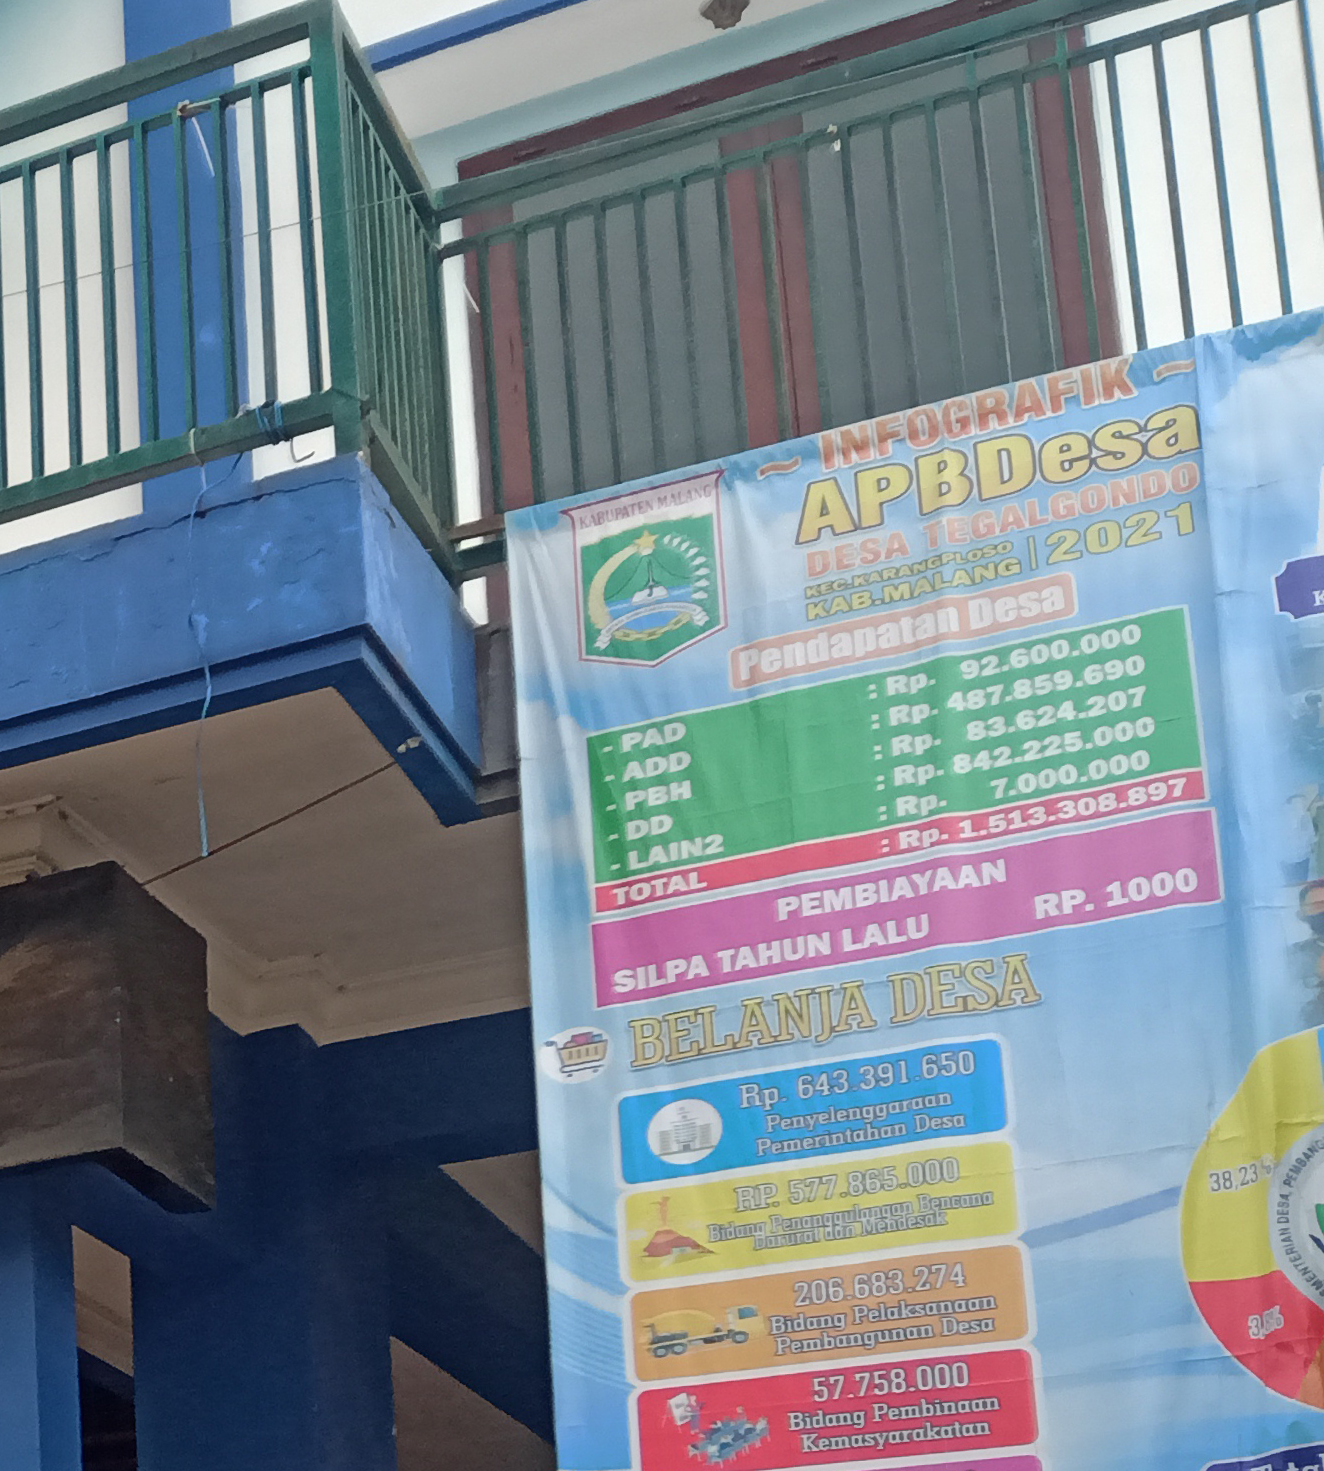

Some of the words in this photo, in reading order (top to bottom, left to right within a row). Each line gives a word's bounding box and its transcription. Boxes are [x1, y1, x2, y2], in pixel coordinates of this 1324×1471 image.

[822, 357, 1138, 471] INFOGRAFIK
[579, 501, 654, 530] KABUPATEN
[656, 484, 713, 510] MALANG
[795, 404, 1200, 545] APBDesa
[806, 530, 910, 579] DESA
[923, 461, 1200, 550] TEGALGONDO
[806, 557, 1021, 622] KAB.MALANG
[1045, 502, 1194, 565] 2021
[806, 541, 1013, 598] KEC.KARANGPLOSO
[738, 602, 960, 684] Pendapatan
[968, 584, 1065, 629] Desa
[620, 722, 686, 753] PAD
[886, 673, 936, 696] Rp.
[959, 624, 1142, 680] 92.600.000
[622, 751, 692, 782] ADD
[888, 704, 938, 727] Rp.
[947, 654, 1146, 713] 487.859.690
[624, 780, 692, 811] PBH
[891, 733, 941, 757] Rp.
[965, 685, 1147, 741] 83.624.207
[626, 814, 673, 841] DD
[893, 764, 945, 787] Rp.
[953, 716, 1155, 774] 842.225.000
[612, 871, 708, 906] TOTAL
[898, 827, 949, 850] Rp.
[959, 777, 1187, 839] 1.513.308.897
[627, 834, 724, 871] LAIN2
[896, 794, 947, 817] Rp.
[991, 750, 1151, 799] 7.000.000
[614, 949, 709, 994] SILPA
[717, 931, 831, 973] TAHUN
[842, 915, 929, 951] LALU
[1034, 891, 1094, 921] RP.
[1106, 867, 1198, 908] 1000
[776, 859, 1007, 921] PEMBIAYAAN
[629, 981, 876, 1068] BELANJA
[889, 954, 1042, 1025] DESA
[766, 1093, 952, 1133] Penyelenggaraan
[797, 1050, 975, 1099] 643.391.650
[756, 1122, 907, 1157] Pemerintahan
[914, 1114, 966, 1133] Desa
[788, 1157, 960, 1206] 577.865.000
[770, 1311, 846, 1335] Bidang
[852, 1296, 996, 1325] Pelaksanaan
[794, 1263, 965, 1307] 206.683.274
[775, 1324, 934, 1356] Pembangunan
[940, 1318, 995, 1336] Desa
[788, 1407, 865, 1431] Bidang
[872, 1397, 999, 1422] Pembinaan
[811, 1362, 969, 1402] 57.758.000
[801, 1421, 991, 1453] Kemasyarakatan
